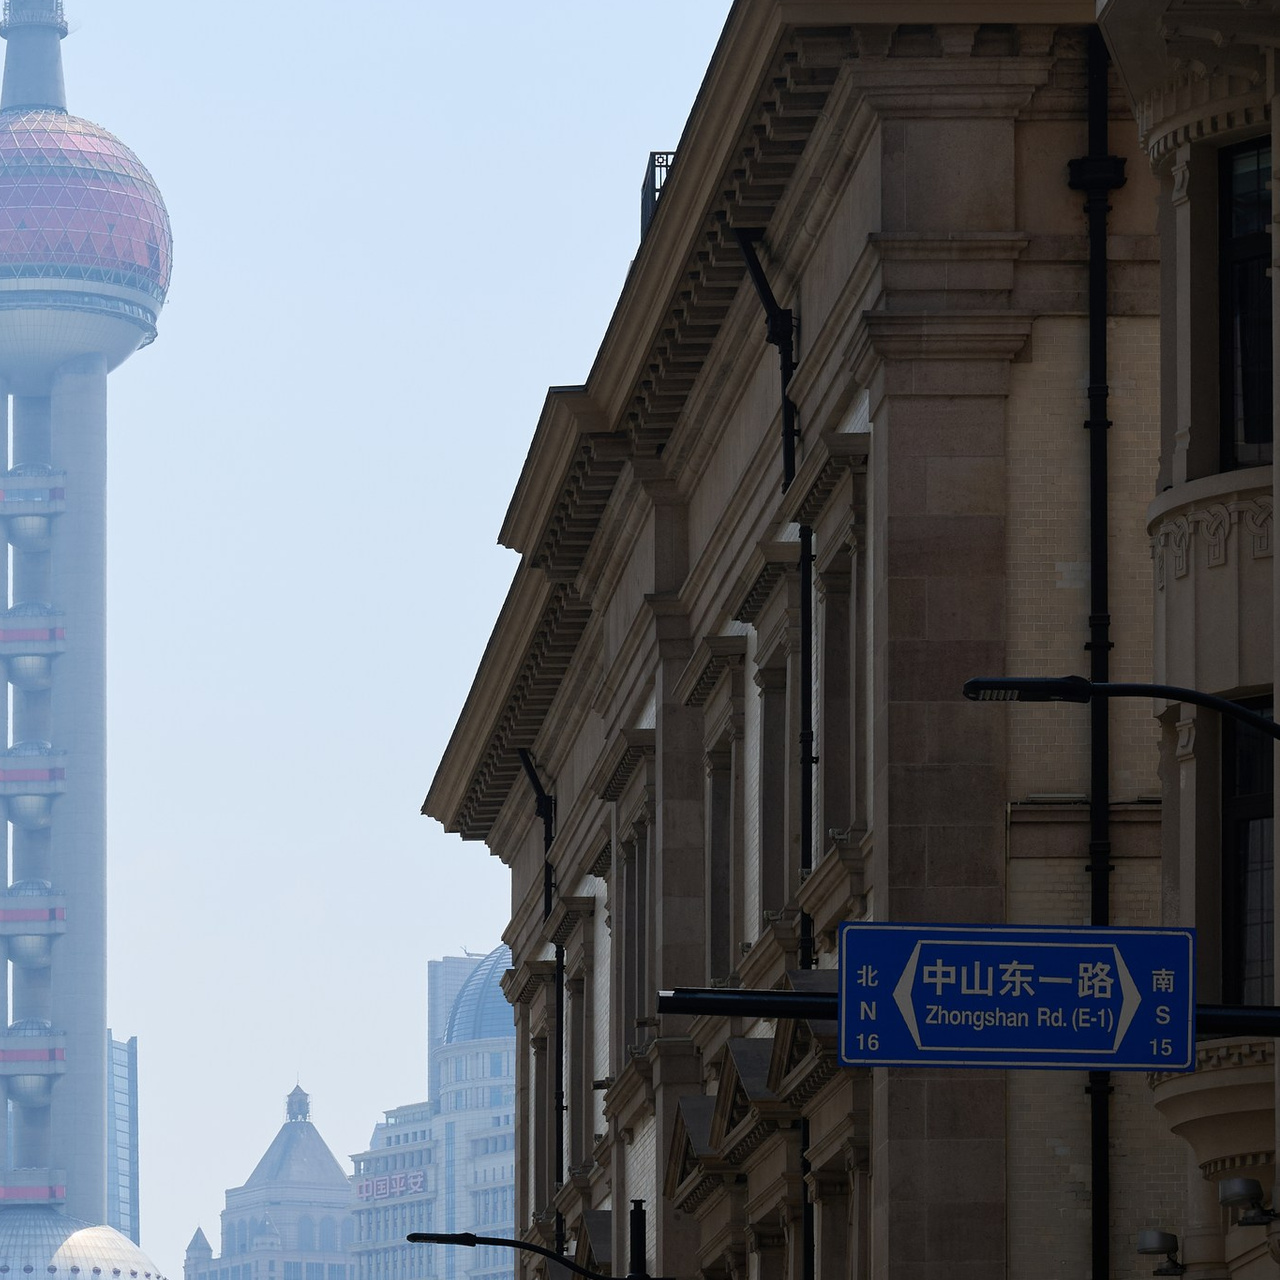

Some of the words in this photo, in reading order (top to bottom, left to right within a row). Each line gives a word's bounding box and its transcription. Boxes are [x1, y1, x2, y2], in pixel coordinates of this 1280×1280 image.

[856, 964, 879, 987] 北
[922, 958, 1115, 999] 中山东一路
[1151, 968, 1176, 993] 南
[860, 1001, 877, 1021] N
[925, 1005, 1029, 1031] Zhongshan
[1037, 1007, 1068, 1028] Rd.
[1071, 1007, 1115, 1033] (E-1)
[1155, 1005, 1171, 1025] S
[856, 1033, 880, 1052] 16
[1149, 1039, 1173, 1057] 15
[357, 1171, 424, 1202] 中国平安
